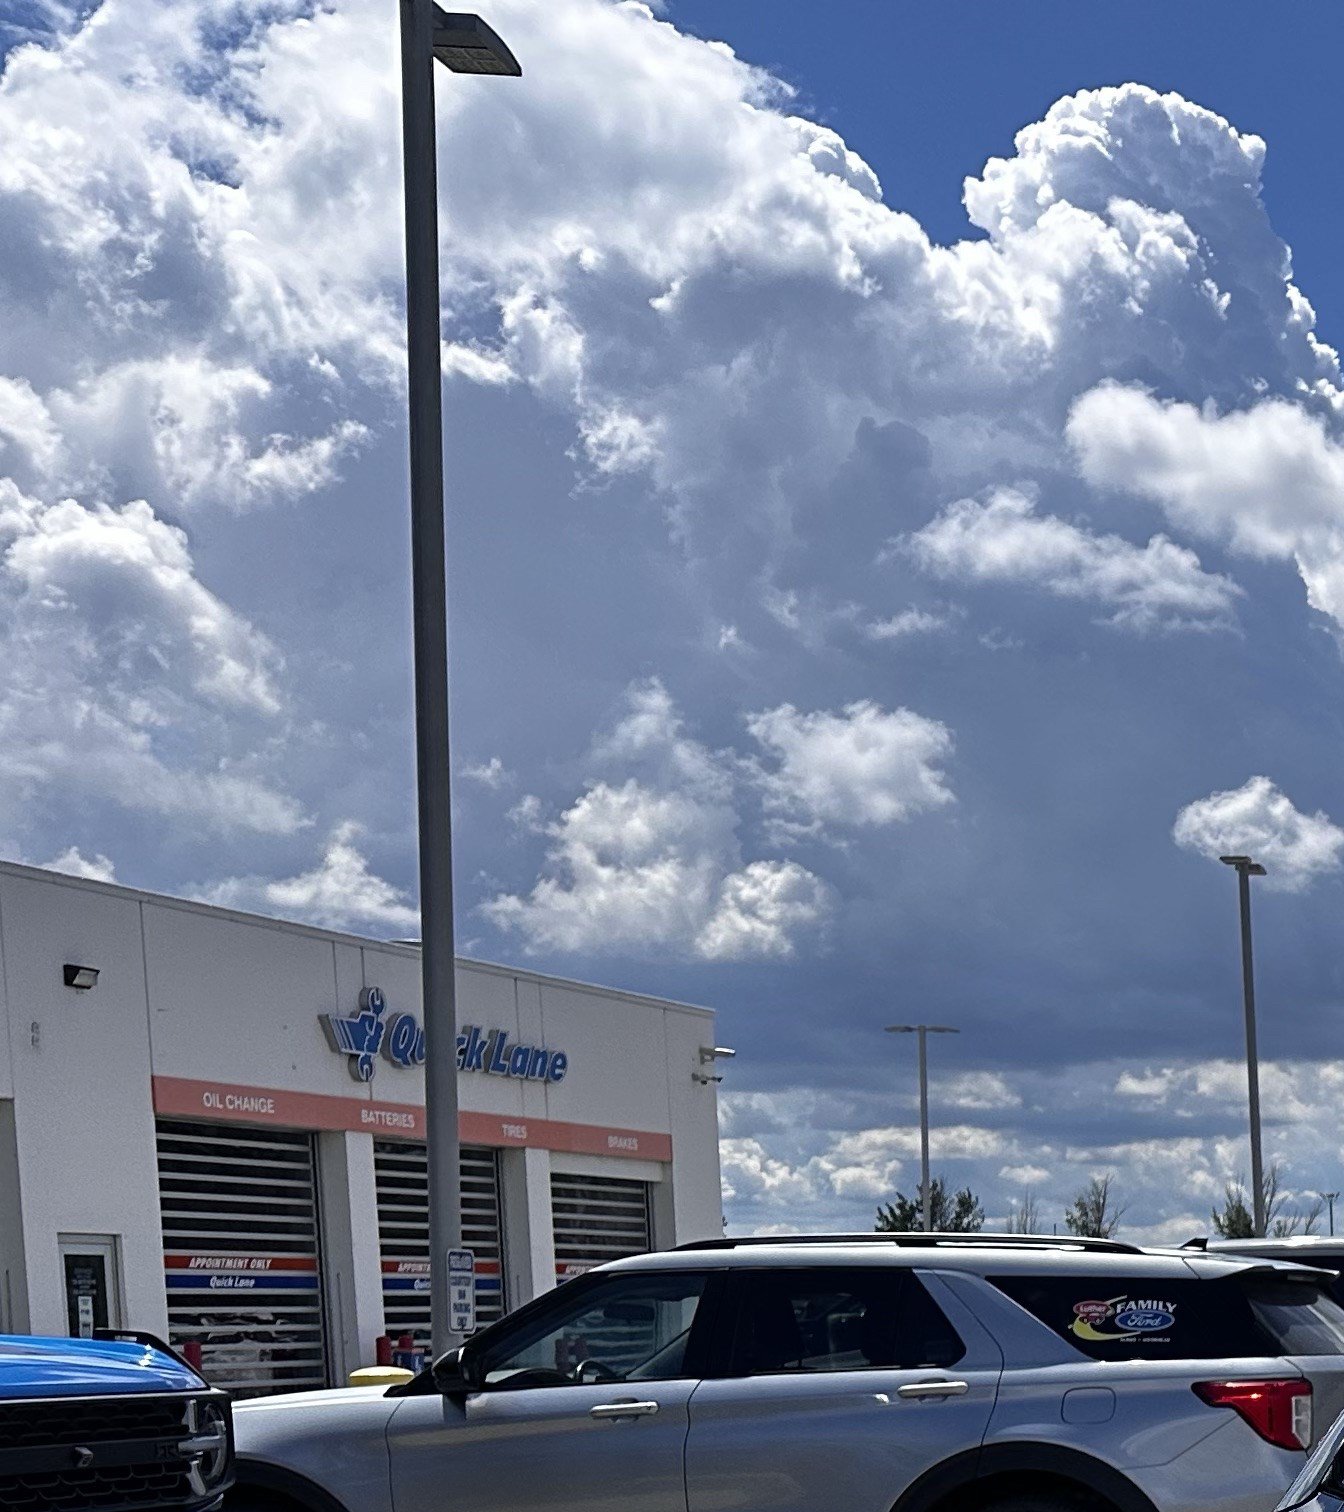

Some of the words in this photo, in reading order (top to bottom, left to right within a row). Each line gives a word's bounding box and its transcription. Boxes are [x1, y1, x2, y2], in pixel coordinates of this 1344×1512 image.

[389, 1012, 487, 1070] Quck
[489, 1029, 569, 1084] Lane
[203, 1092, 223, 1109] OIL
[225, 1094, 275, 1114] CHANGE
[361, 1109, 416, 1129] BATTERIES
[502, 1124, 527, 1139] TIRES
[607, 1134, 639, 1151] BRAKES
[188, 1257, 249, 1269] APPOINTMENT
[250, 1258, 272, 1270] ONLY
[210, 1275, 233, 1289] Quick
[1116, 1299, 1178, 1314] FAMILY
